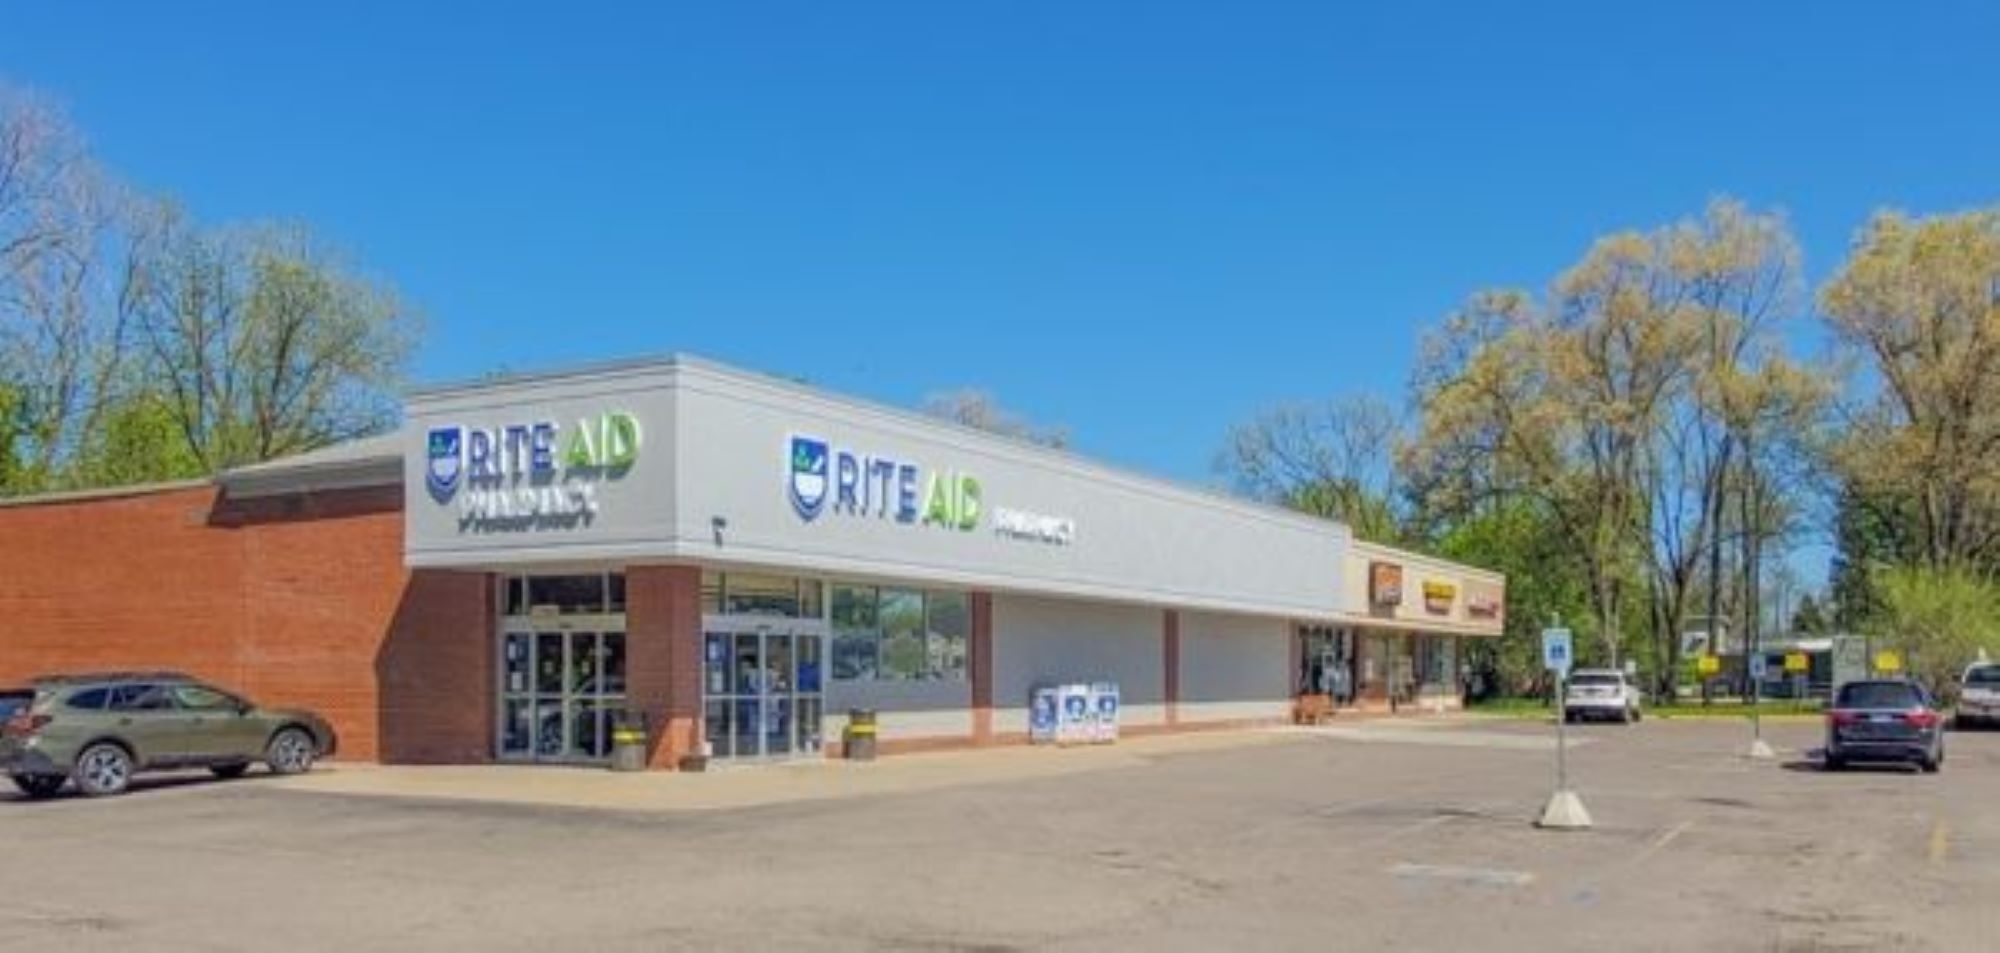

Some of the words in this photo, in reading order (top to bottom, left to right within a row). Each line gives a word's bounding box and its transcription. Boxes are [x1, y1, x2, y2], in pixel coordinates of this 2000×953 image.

[463, 421, 556, 476] RITE
[565, 412, 641, 470] AID
[836, 451, 916, 521] RITE
[922, 468, 982, 529] AID
